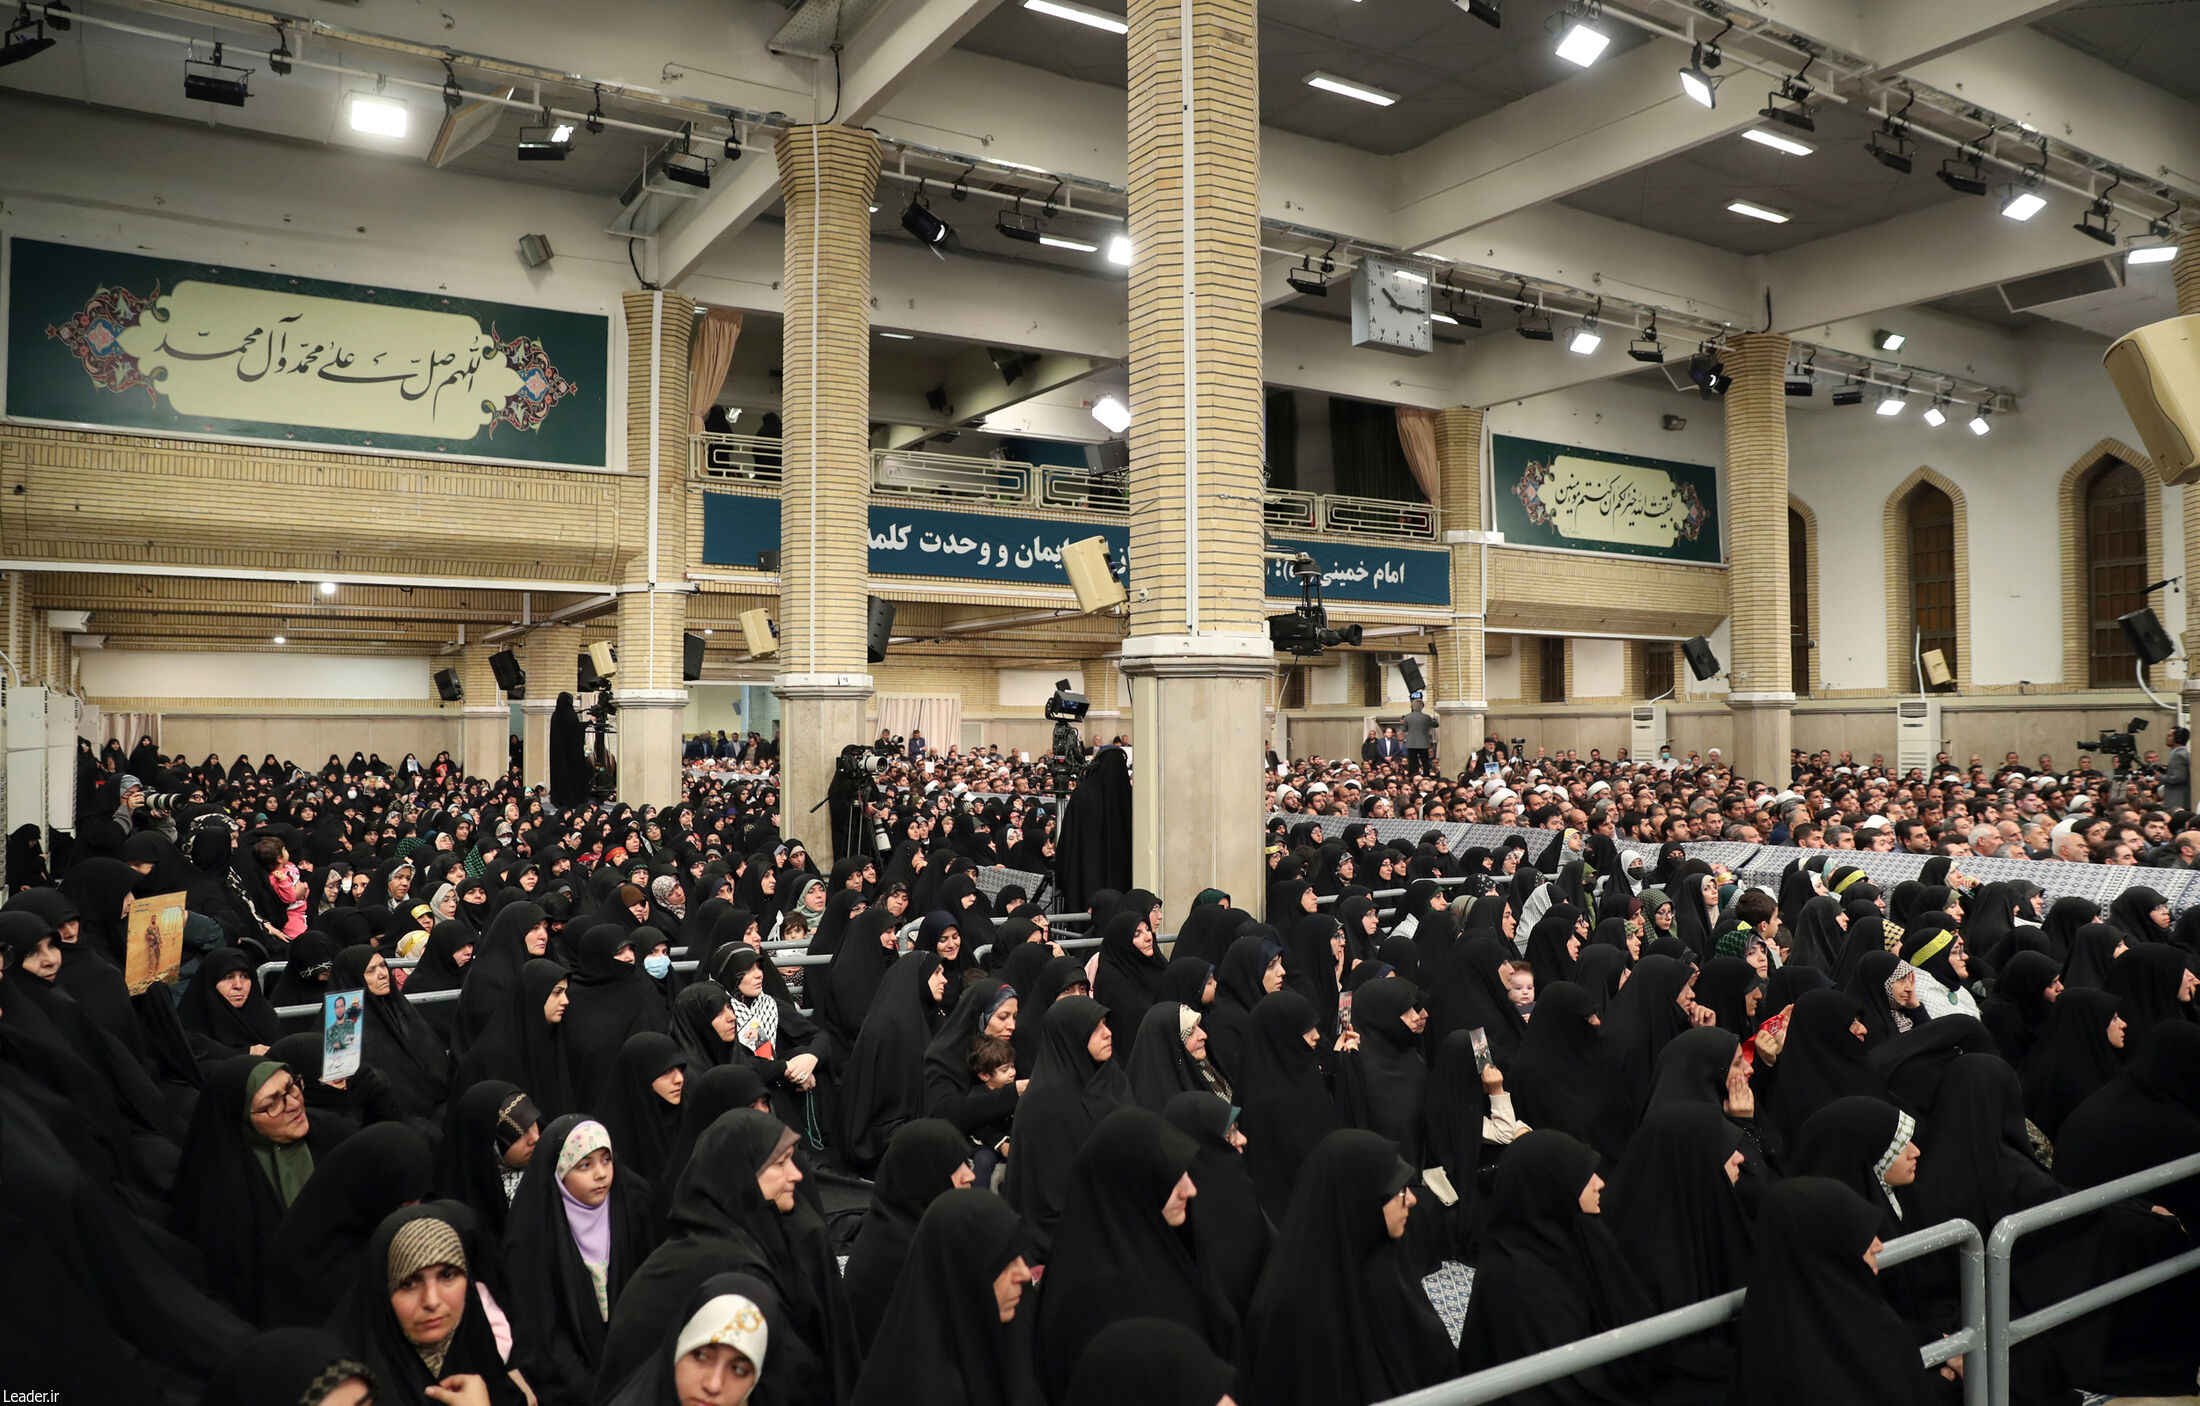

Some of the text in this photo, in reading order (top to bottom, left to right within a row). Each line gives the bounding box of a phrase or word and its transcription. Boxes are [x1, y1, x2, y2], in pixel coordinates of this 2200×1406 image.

[919, 531, 991, 566] وحدت
[995, 543, 1009, 567] و
[1319, 560, 1369, 587] خمینی
[1373, 561, 1405, 589] امام
